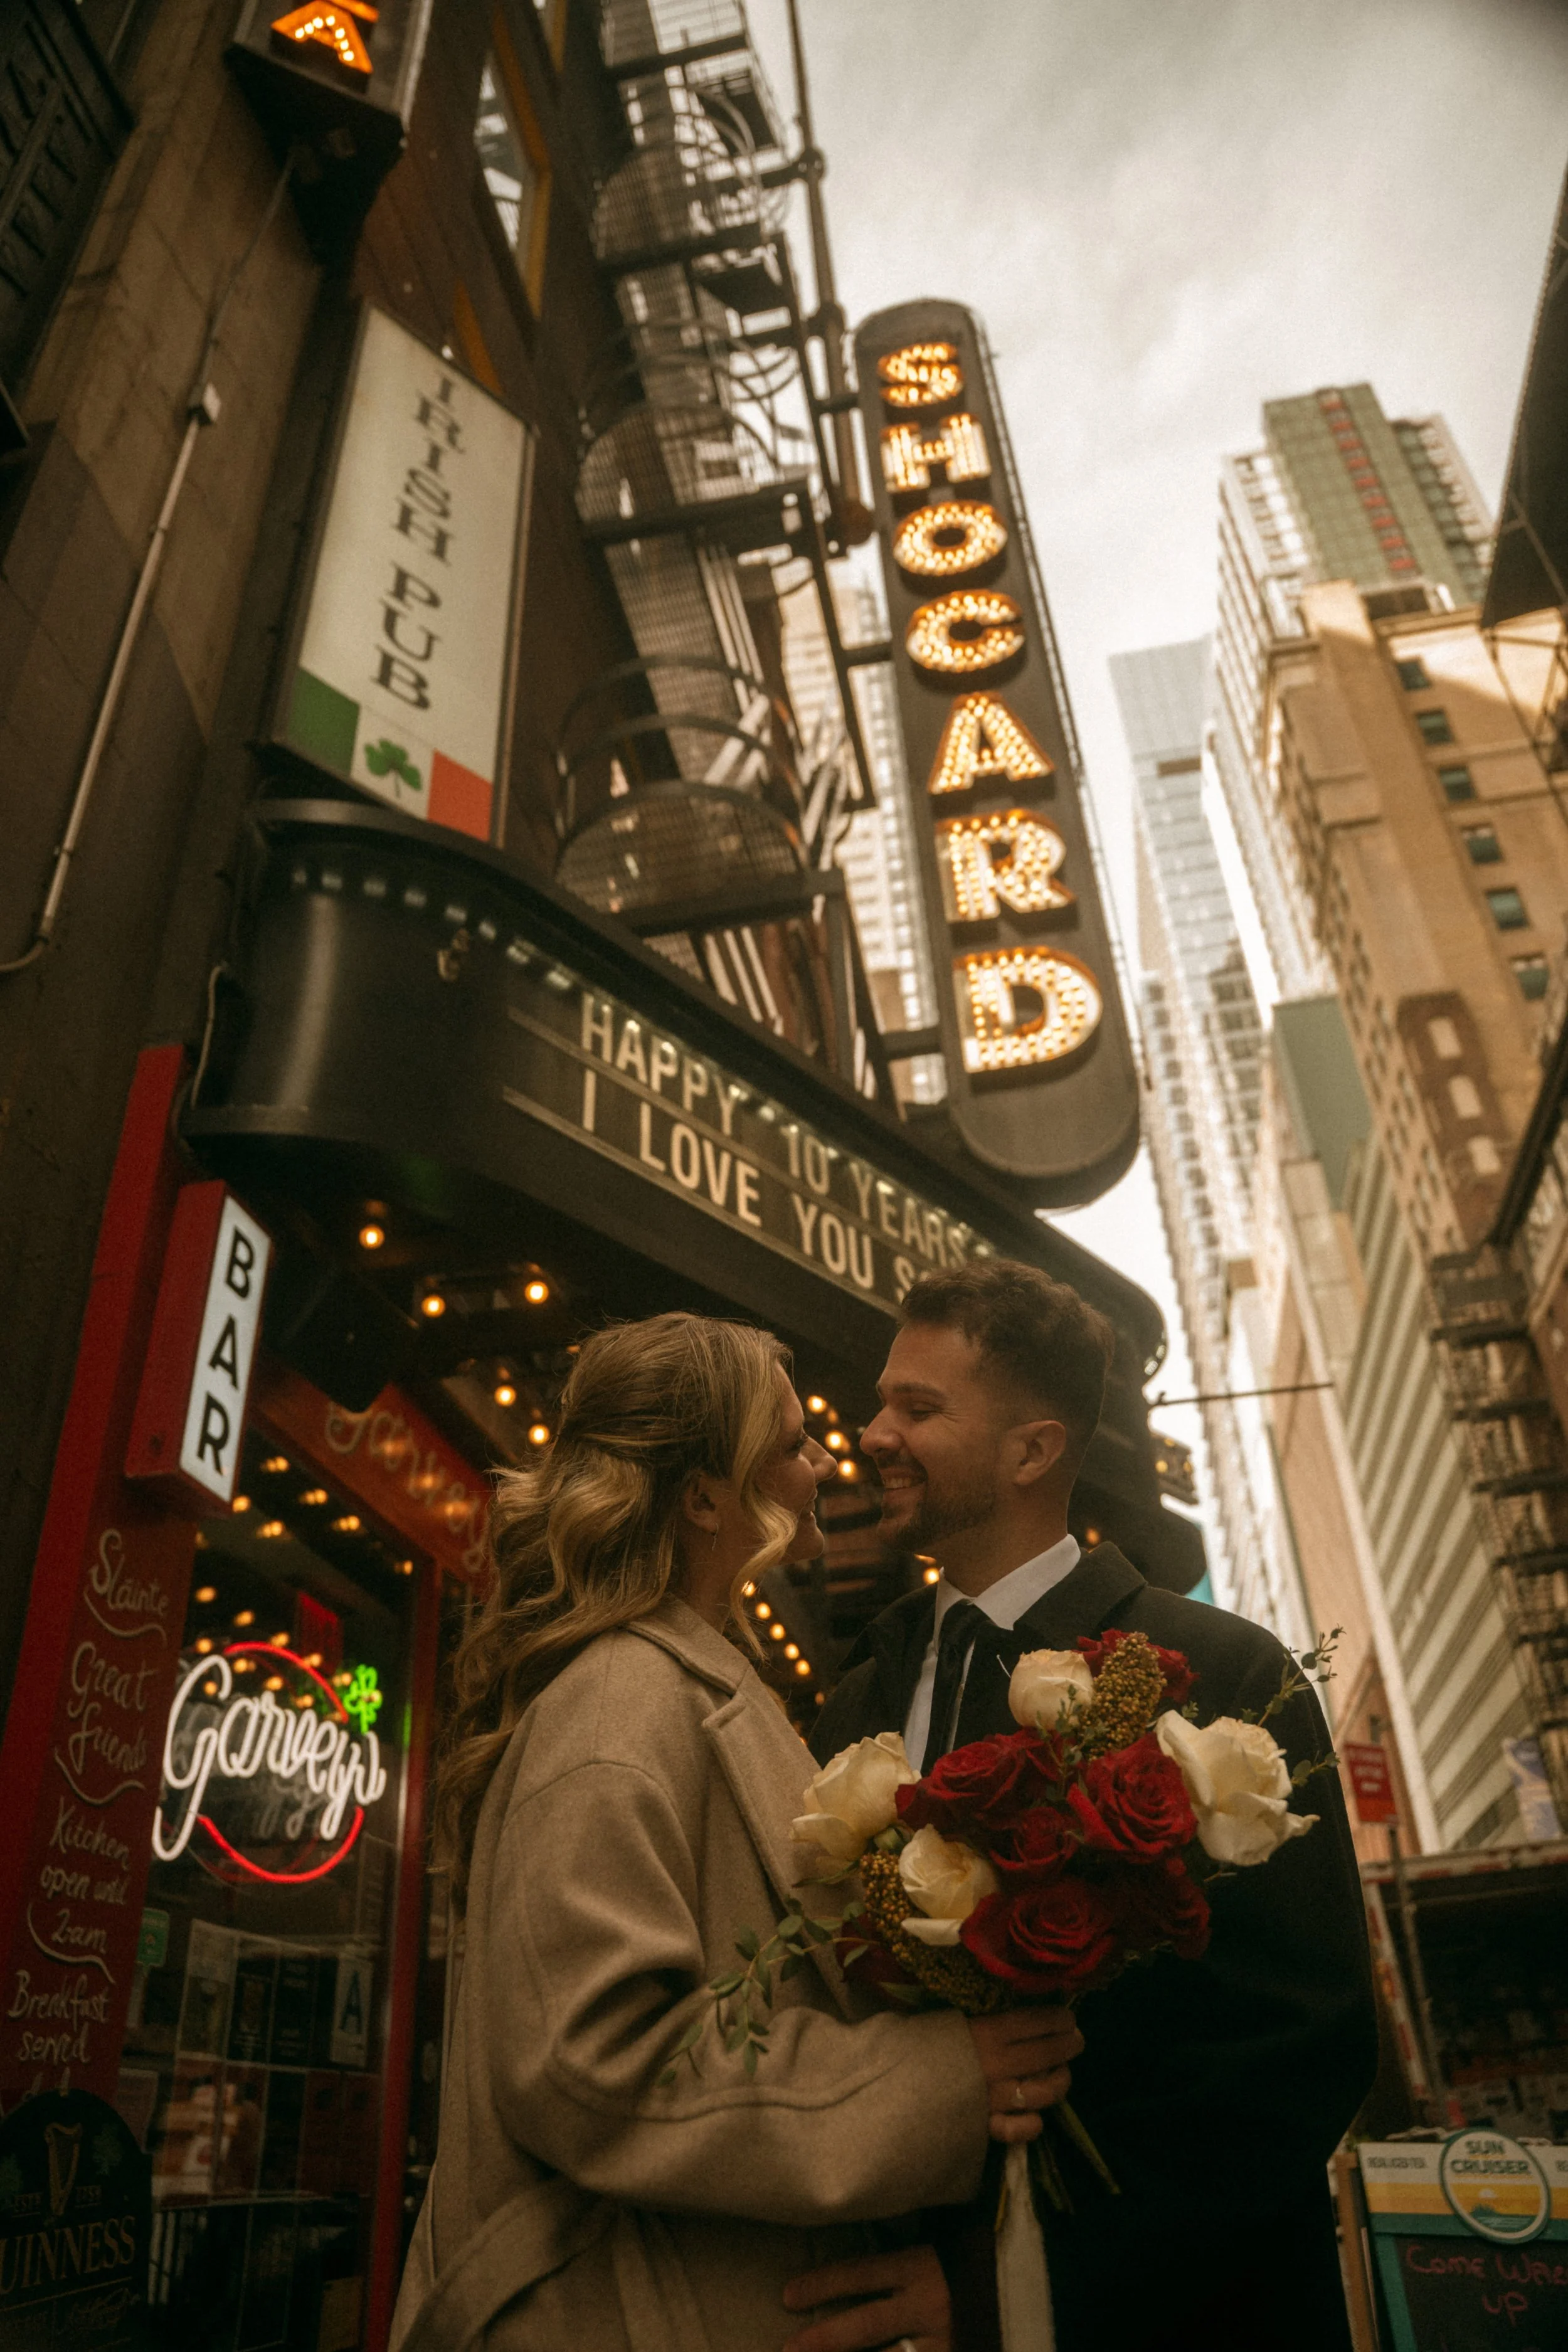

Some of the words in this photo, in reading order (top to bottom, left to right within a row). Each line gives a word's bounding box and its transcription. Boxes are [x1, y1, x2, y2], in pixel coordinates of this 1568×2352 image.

[390, 373, 467, 566] IRISH
[372, 560, 442, 712] PUB
[878, 342, 1104, 1074] SHOCARD
[581, 992, 741, 1135] HAPPY
[783, 1121, 830, 1194] 10
[581, 1068, 597, 1131] I
[639, 1102, 763, 1227] LOVE
[792, 1193, 874, 1290] YOU
[196, 1225, 255, 1478] BAR
[67, 1641, 161, 1718] Great
[40, 1865, 91, 1900] open
[50, 1797, 130, 1870] Kitchen
[340, 1971, 363, 2034] A
[1450, 2159, 1532, 2175] CRUISER
[1465, 2139, 1506, 2155] SUN
